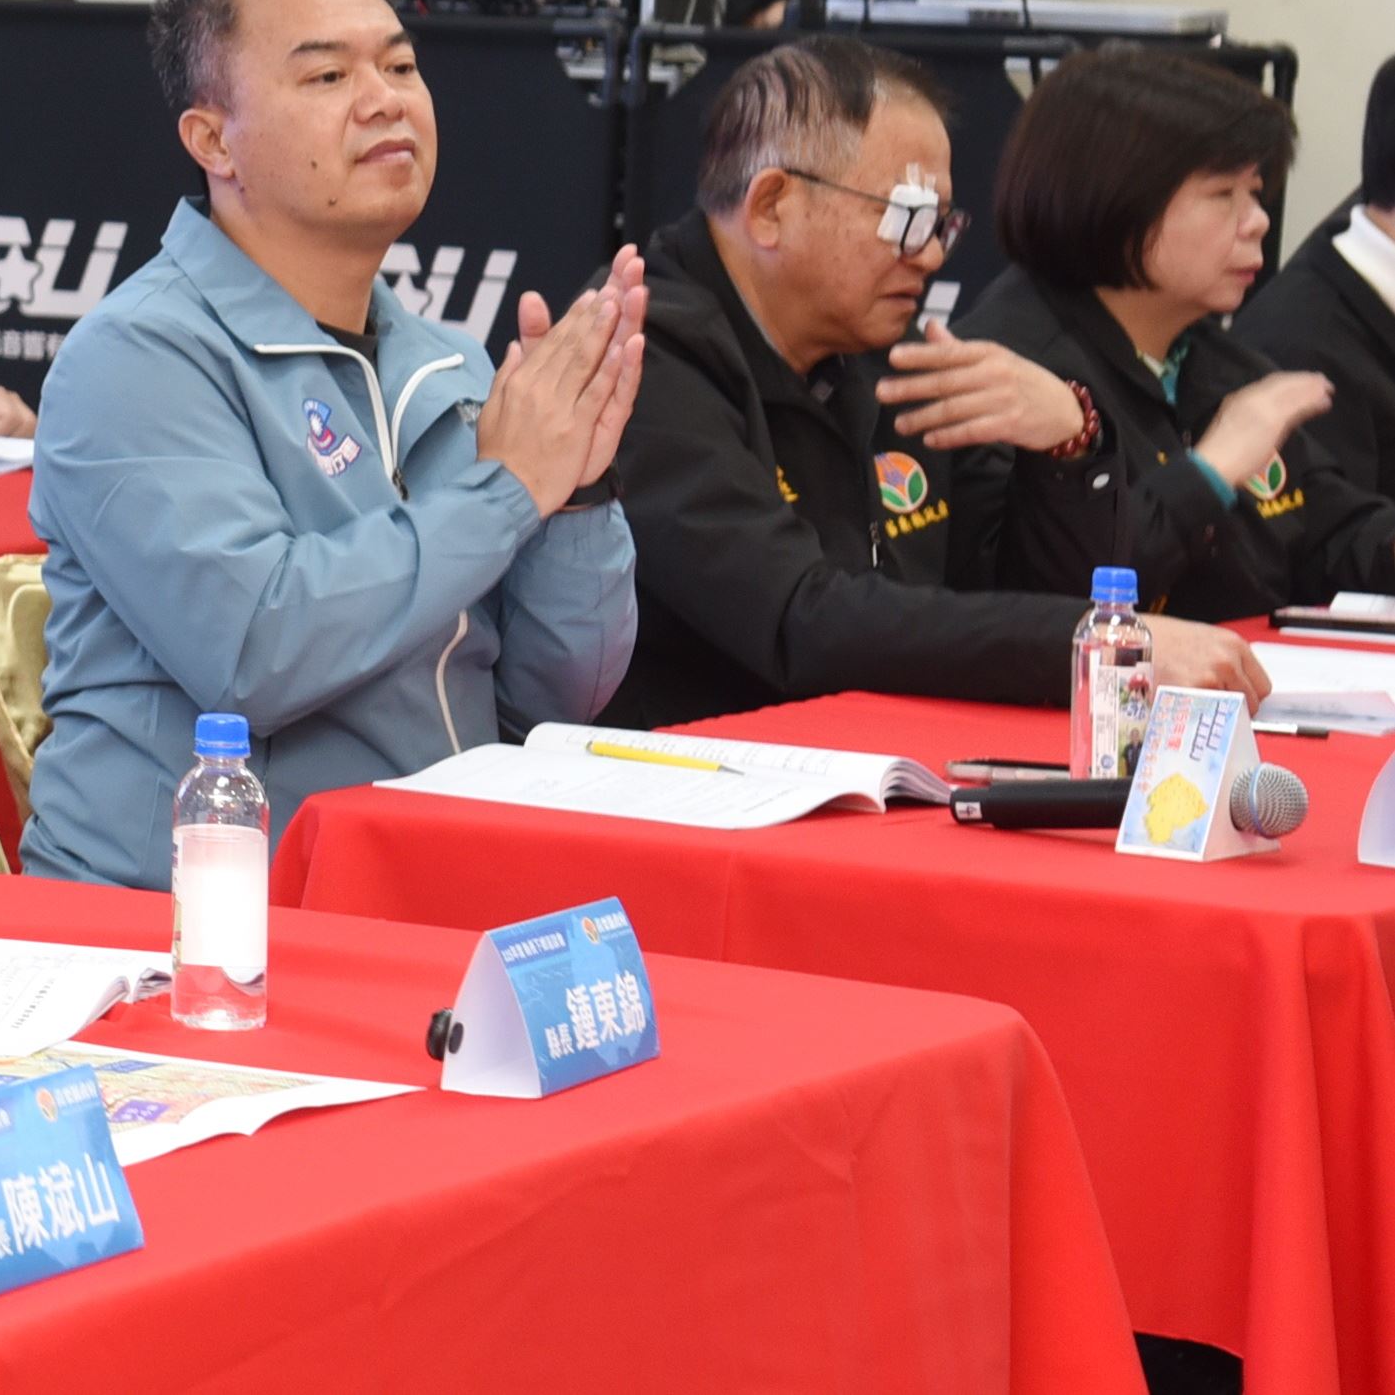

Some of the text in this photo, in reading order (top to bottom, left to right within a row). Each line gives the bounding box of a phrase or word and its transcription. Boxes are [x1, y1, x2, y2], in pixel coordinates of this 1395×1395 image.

[566, 969, 647, 1052] 鍾東錦
[0, 1152, 121, 1254] 陳斌山
